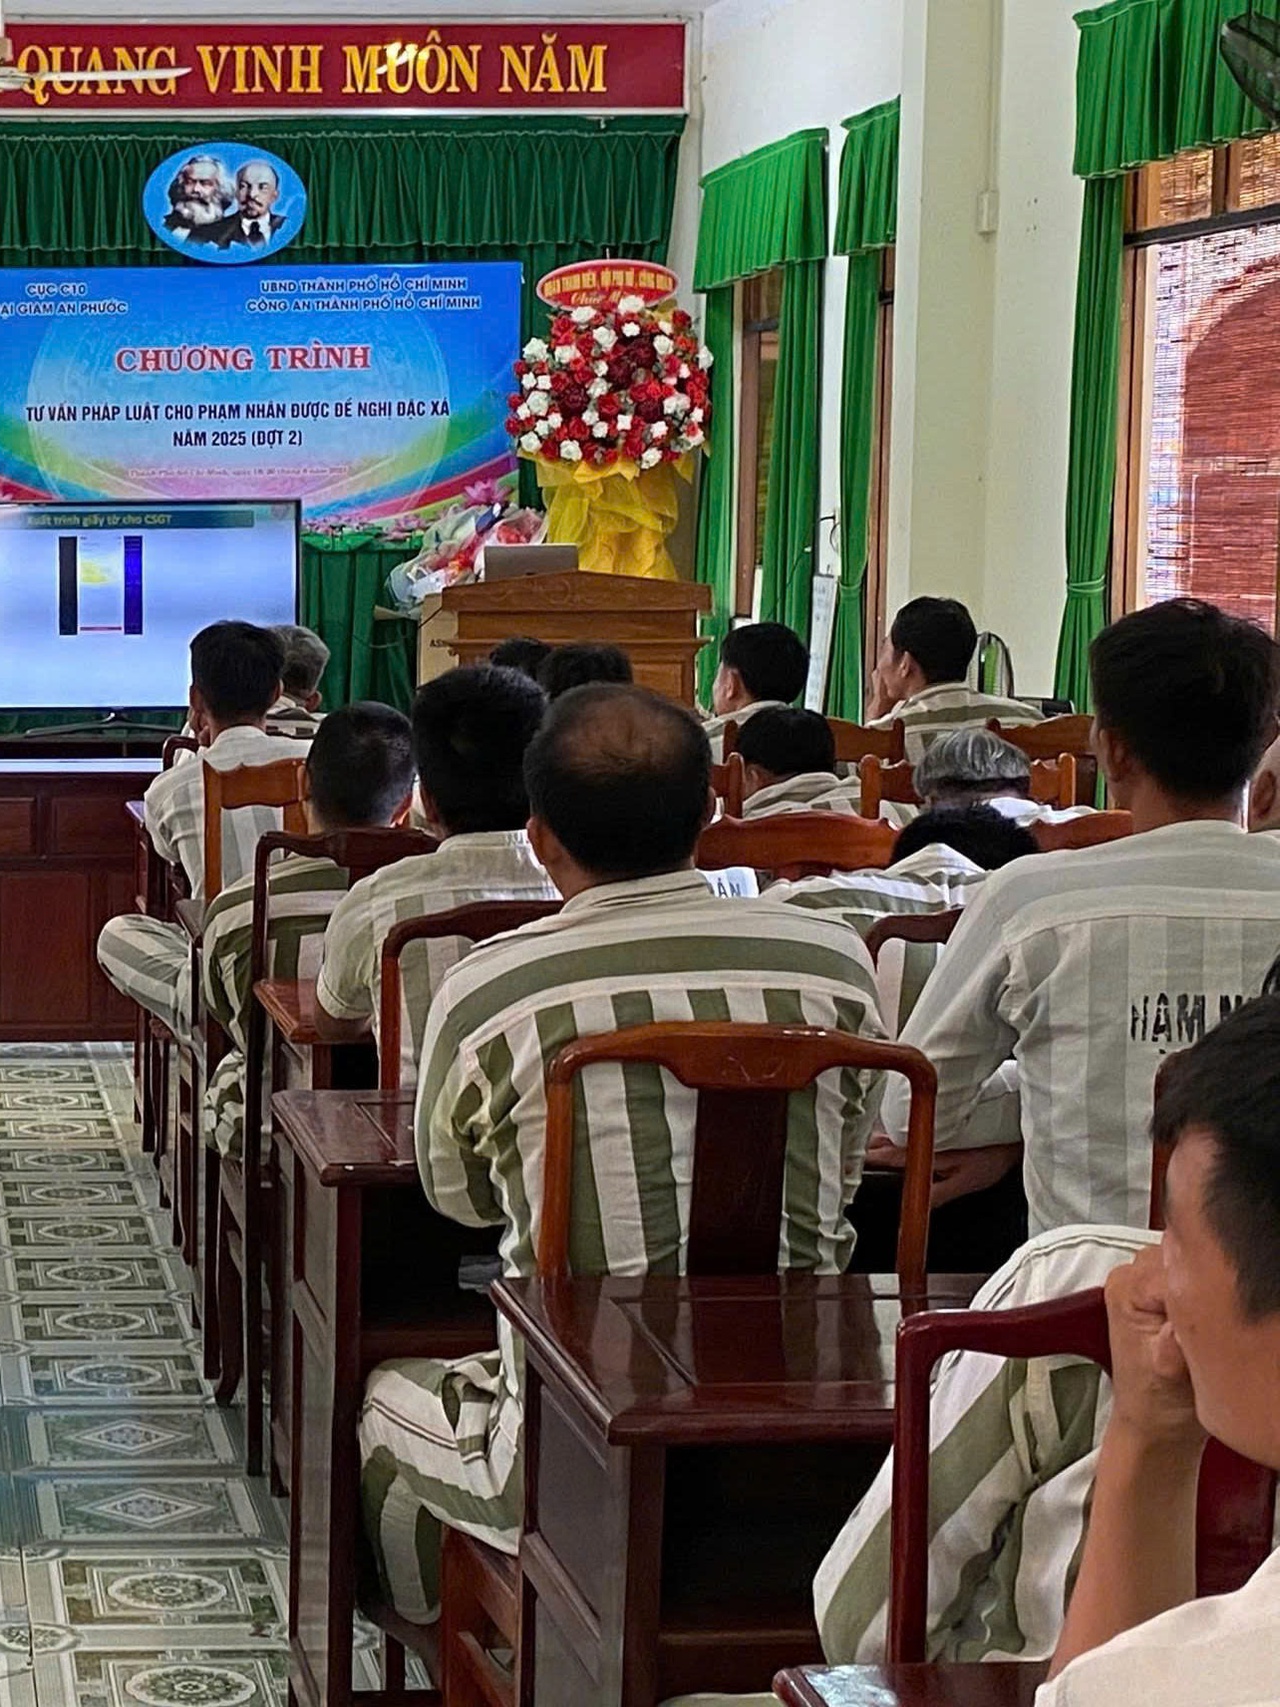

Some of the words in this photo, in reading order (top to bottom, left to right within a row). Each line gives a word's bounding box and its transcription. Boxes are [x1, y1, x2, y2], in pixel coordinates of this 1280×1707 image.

[18, 45, 176, 105] QUANG
[196, 45, 323, 94] VINH
[341, 29, 481, 94] MUÔN
[499, 31, 608, 94] NĂM
[26, 283, 56, 299] CỤC
[60, 283, 86, 295] C10
[261, 281, 296, 293] UBND
[301, 277, 344, 292] THÀNH
[349, 274, 378, 291] PHỐ
[381, 273, 400, 290] HỒ
[405, 275, 428, 290] CHÍ
[432, 279, 466, 290] MINH
[18, 303, 54, 315] GIAM
[57, 303, 75, 314] AN
[80, 298, 127, 314] PHƯỚC
[247, 297, 288, 311] CÔNG
[293, 300, 310, 311] AN
[315, 295, 358, 310] THÀNH
[363, 293, 392, 308] PHỐ
[395, 291, 414, 308] HỒ
[419, 293, 442, 308] CHÍ
[446, 297, 480, 308] MINH
[116, 345, 254, 371] CHƯƠNG
[266, 341, 370, 370] TRÌNH
[26, 404, 45, 422] TƯ
[48, 401, 77, 421] VẤN
[82, 402, 120, 421] PHÁP
[125, 402, 159, 424] LUẬT
[165, 404, 193, 420] CHO
[199, 403, 240, 423] PHẠM
[246, 401, 286, 419] NHÂN
[291, 401, 329, 422] ĐƯỢC
[358, 401, 392, 420] NGHỊ
[397, 398, 426, 420] ĐẶC
[430, 397, 449, 416] XÁ
[173, 427, 206, 447] NĂM
[211, 430, 246, 447] 2025
[252, 429, 283, 449] (ĐỢT
[289, 430, 302, 447] 2)
[123, 514, 142, 525] cho
[144, 514, 172, 525] CSGT
